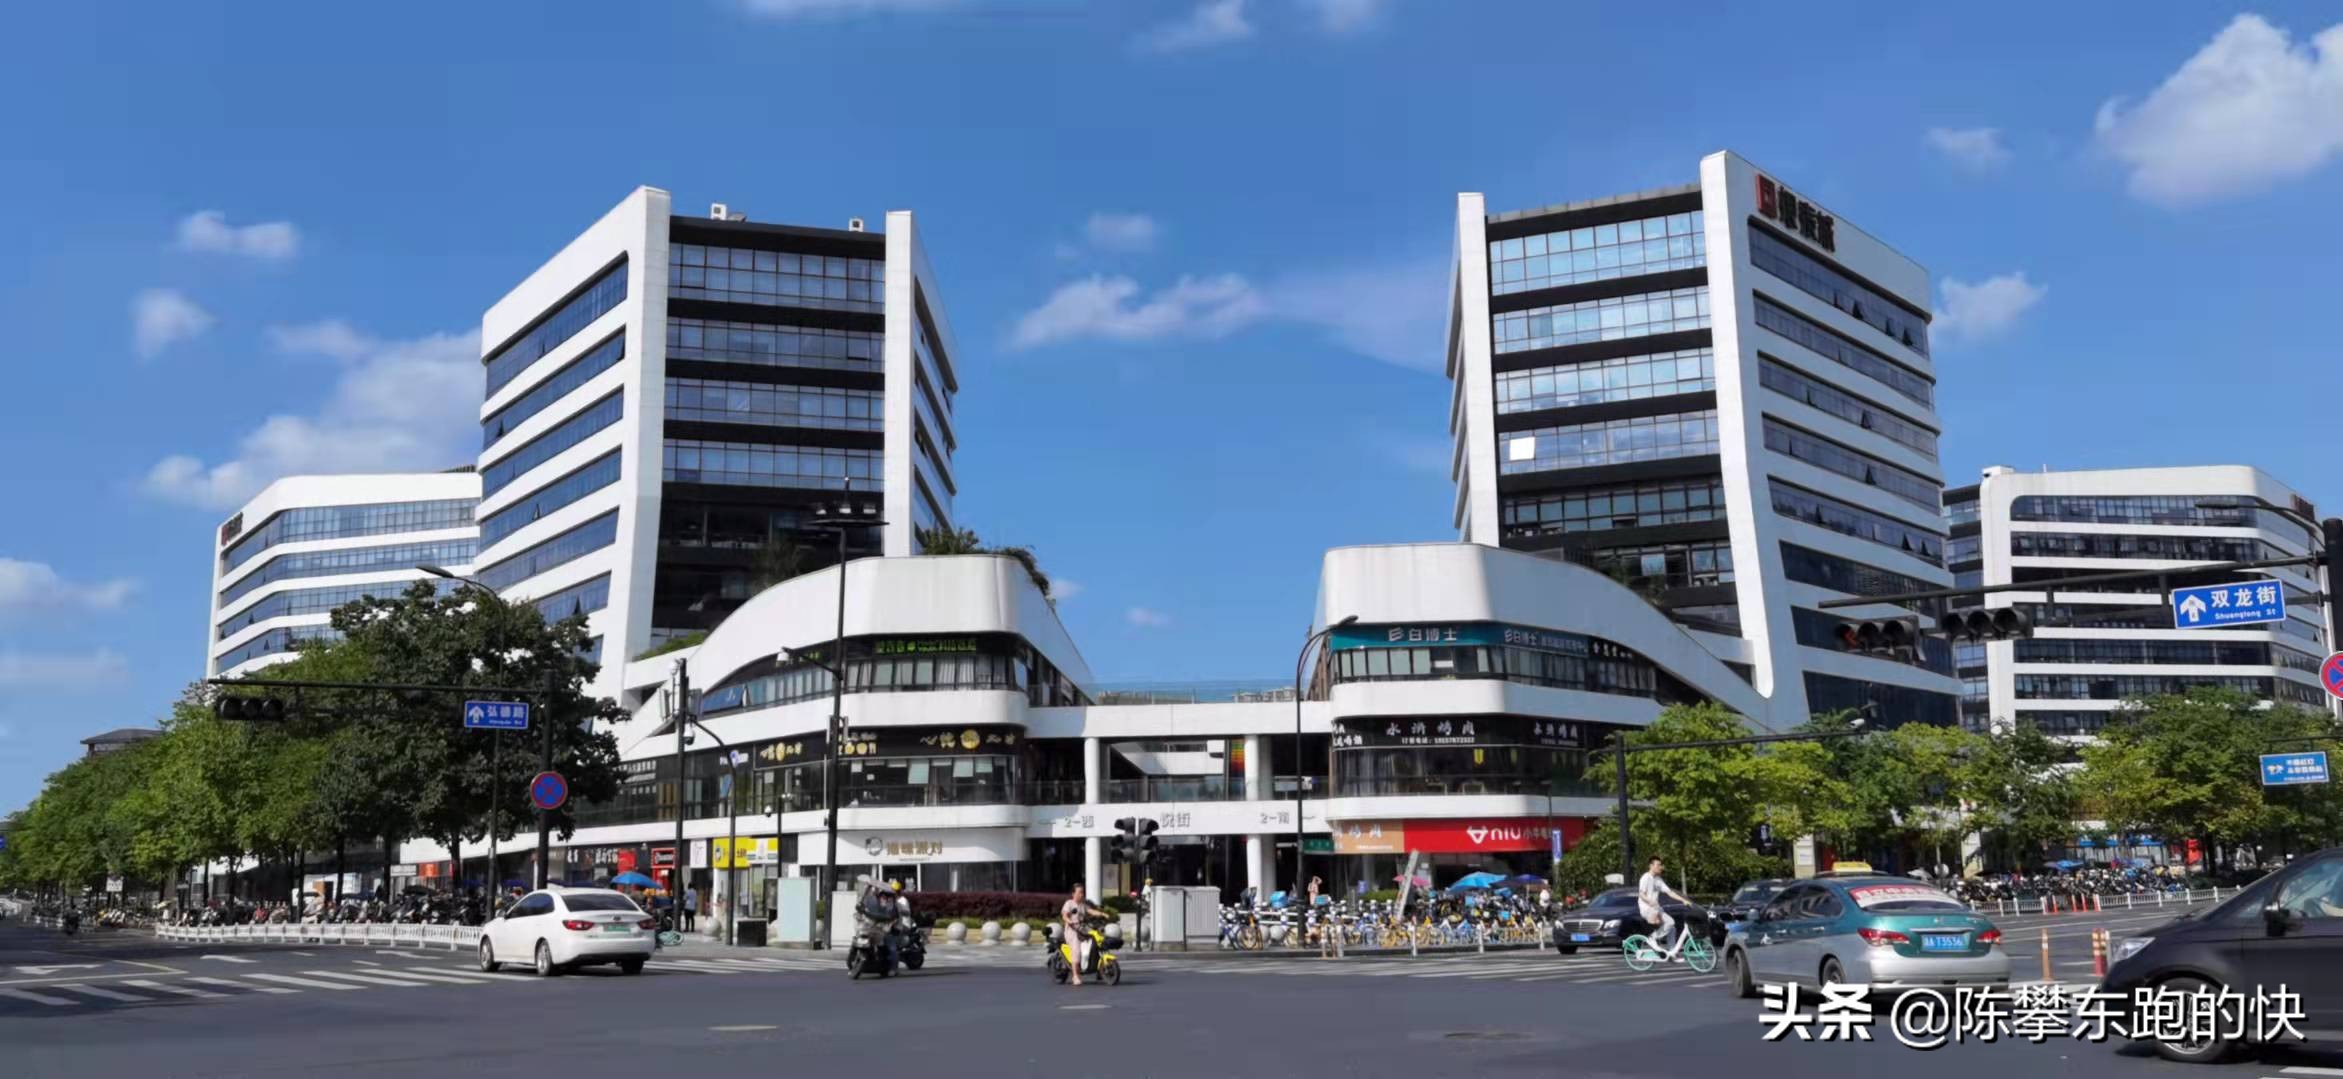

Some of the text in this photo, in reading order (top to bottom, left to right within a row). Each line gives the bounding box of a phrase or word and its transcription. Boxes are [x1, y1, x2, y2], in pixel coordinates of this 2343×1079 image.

[2211, 586, 2276, 608] 双龙街
[2215, 608, 2276, 620] Shuanglong St
[1409, 628, 1457, 641] 白博士
[1386, 720, 1475, 736] 水浒烤肉
